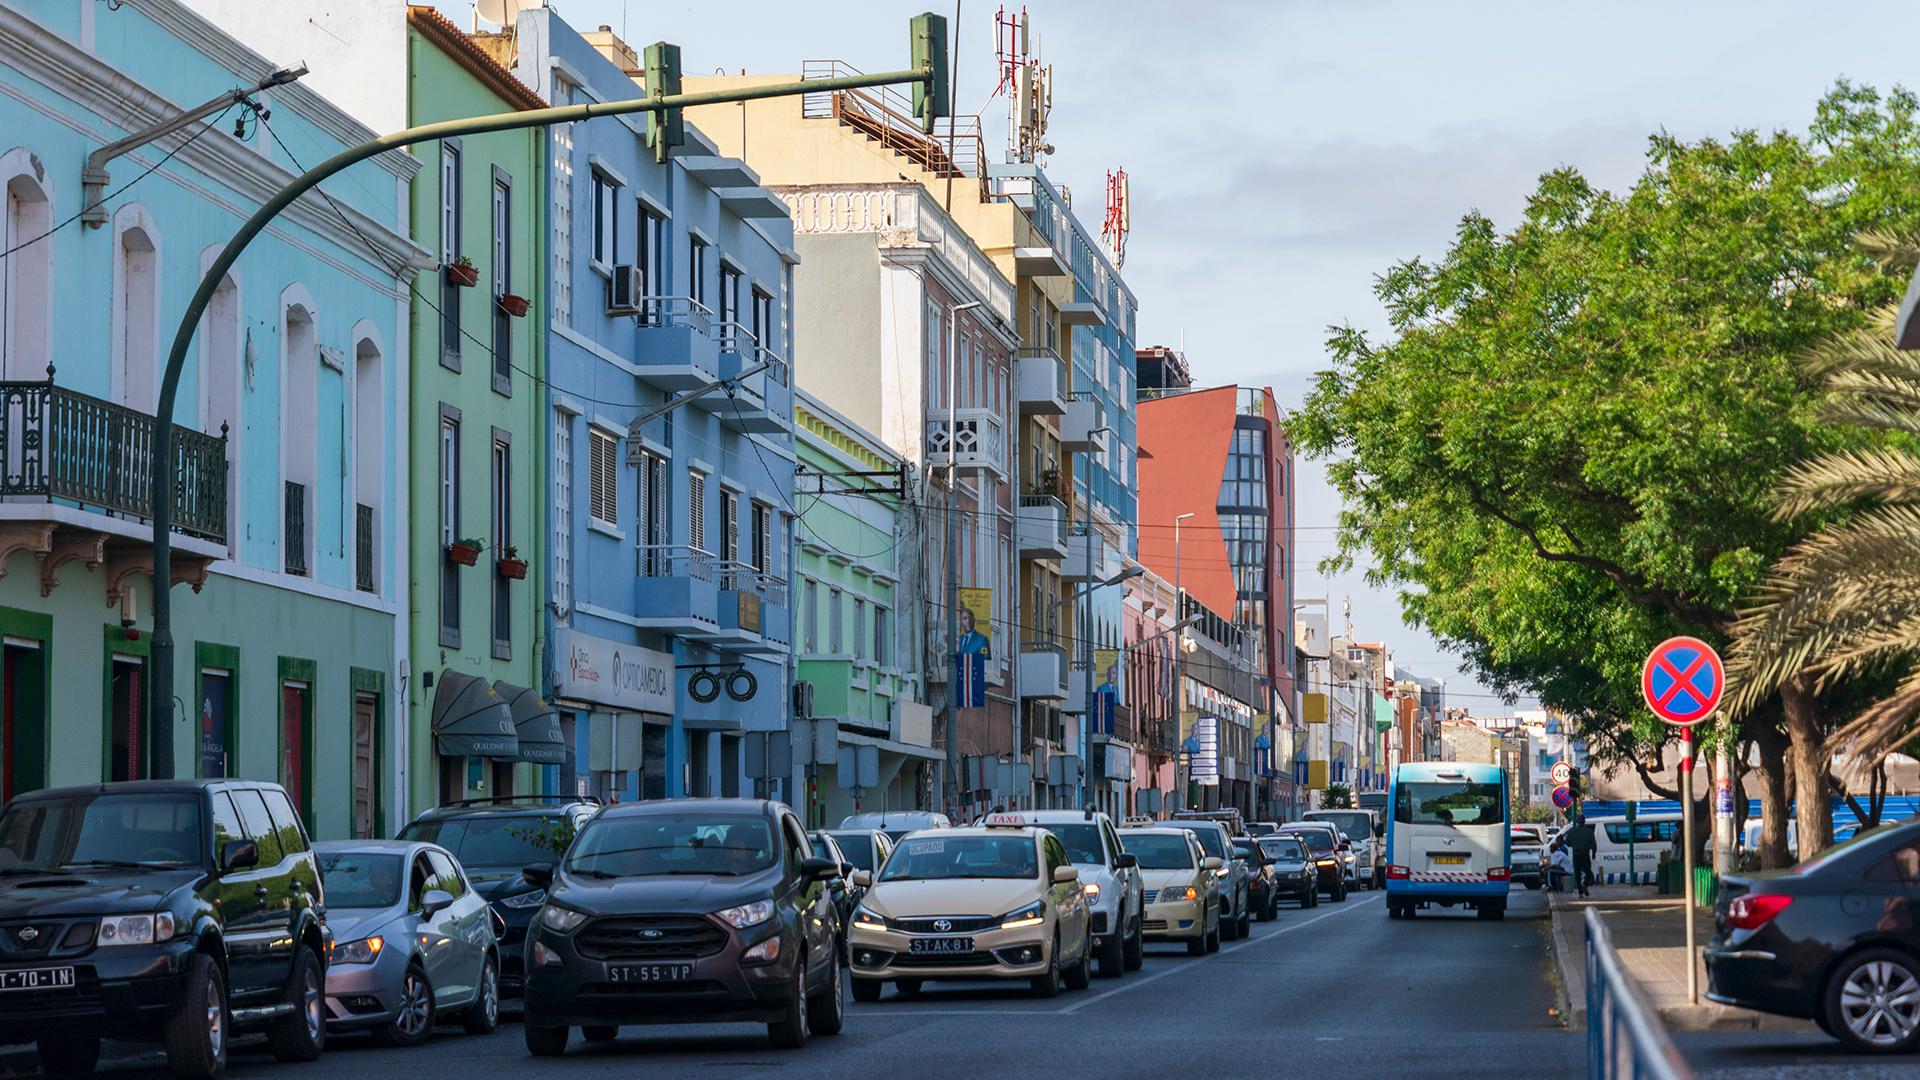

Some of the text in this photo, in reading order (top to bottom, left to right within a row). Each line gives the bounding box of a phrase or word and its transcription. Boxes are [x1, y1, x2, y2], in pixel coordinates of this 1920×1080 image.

[622, 661, 667, 697] OPTICAMEDICA
[1555, 768, 1570, 778] 40
[993, 815, 1018, 823] TAXI
[911, 843, 943, 853] OCUPADO
